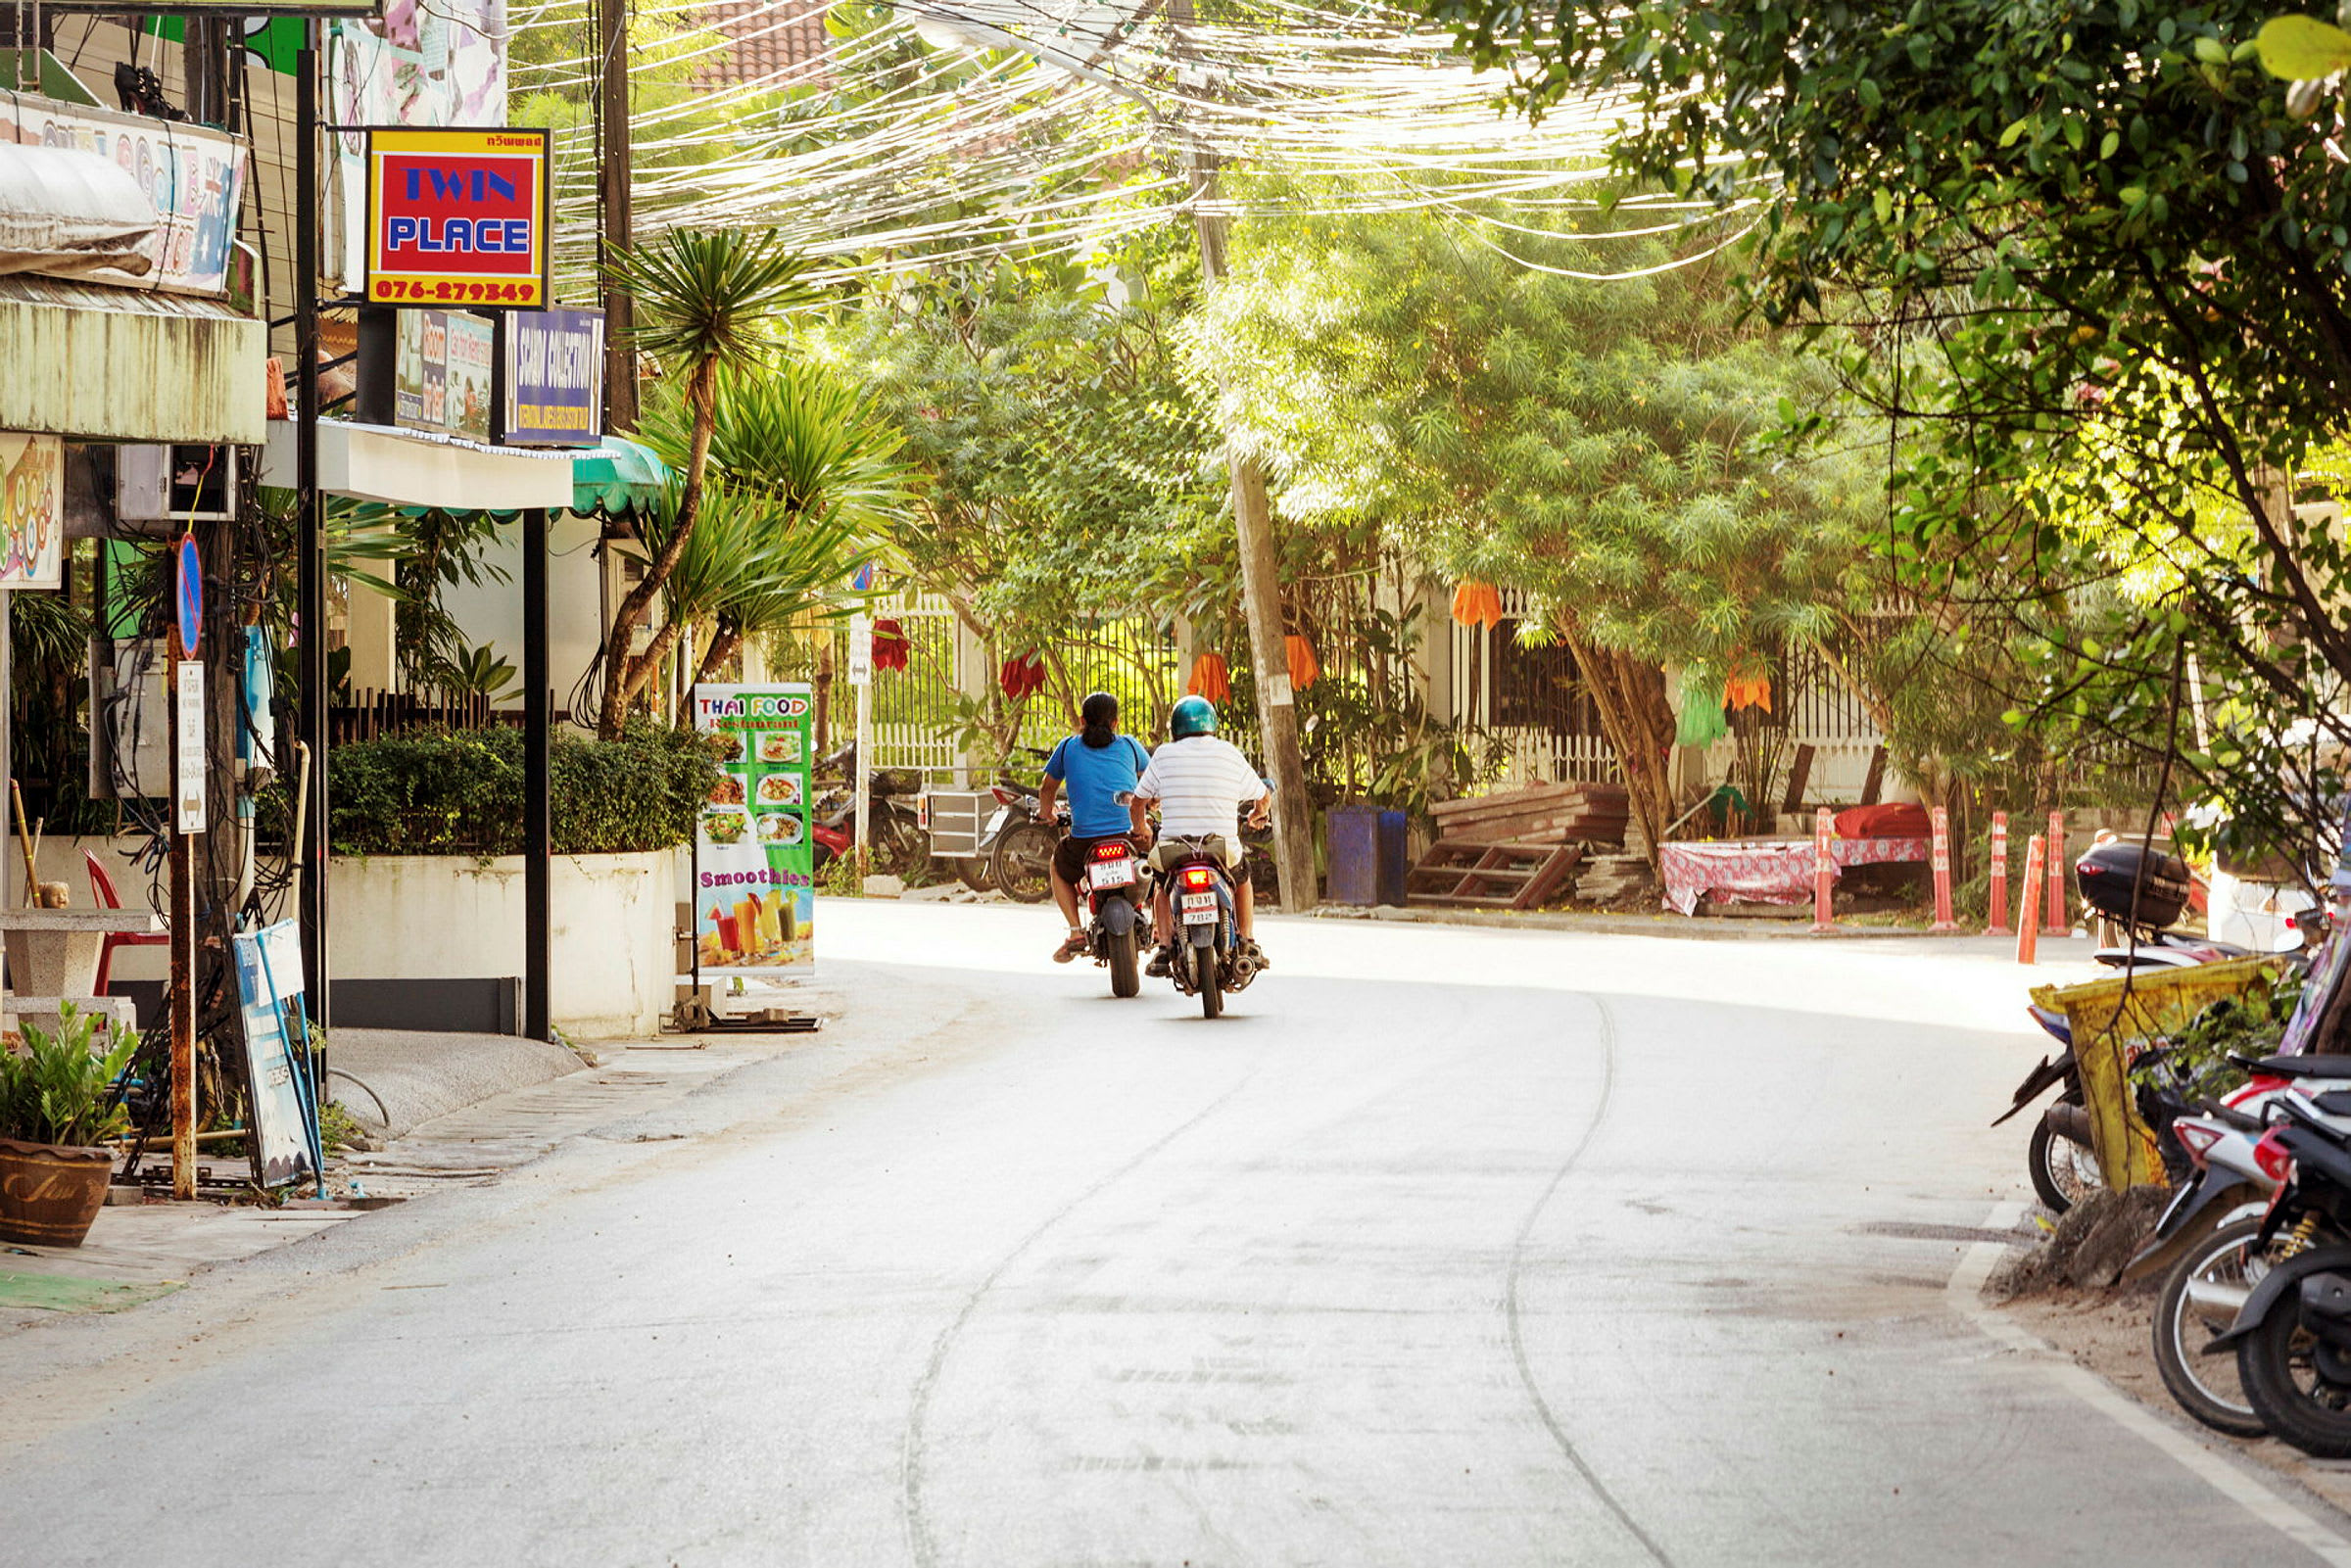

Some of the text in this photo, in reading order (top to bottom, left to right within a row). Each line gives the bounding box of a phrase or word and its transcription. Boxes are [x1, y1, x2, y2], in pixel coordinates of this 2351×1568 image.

[400, 167, 516, 203] TWIN
[387, 215, 530, 254] PLACE
[375, 280, 534, 302] 076-279349
[549, 328, 592, 390] COLLECTION
[698, 697, 807, 716] THAI FOOD
[709, 718, 799, 730] Restaurant
[699, 867, 810, 888] Smoothies
